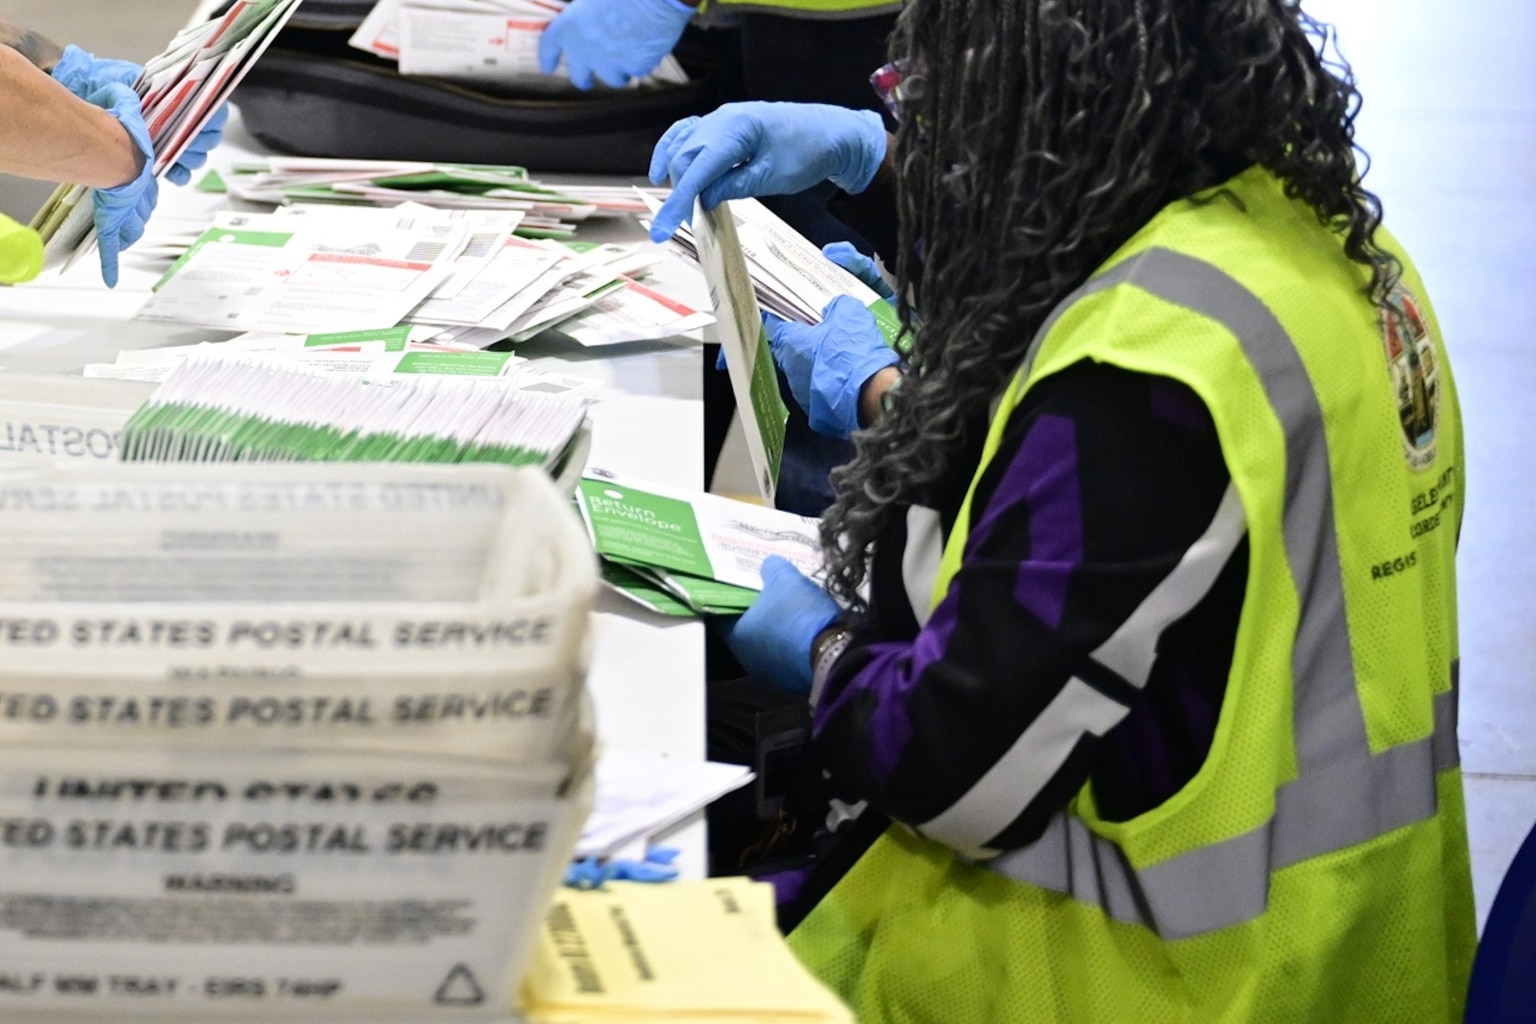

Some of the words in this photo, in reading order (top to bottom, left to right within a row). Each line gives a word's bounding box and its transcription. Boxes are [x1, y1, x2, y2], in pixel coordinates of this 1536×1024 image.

[589, 495, 656, 518] Return
[591, 504, 681, 532] Envelope
[71, 618, 215, 648] STATES
[227, 620, 375, 651] POSTAL
[393, 616, 552, 650] SERVICE
[69, 694, 216, 727] STATES
[227, 695, 373, 726] POSTAL
[393, 687, 552, 723] SERVICE
[67, 819, 210, 854] STATES
[222, 822, 369, 855] POSTAL
[385, 822, 548, 854] SERVICE
